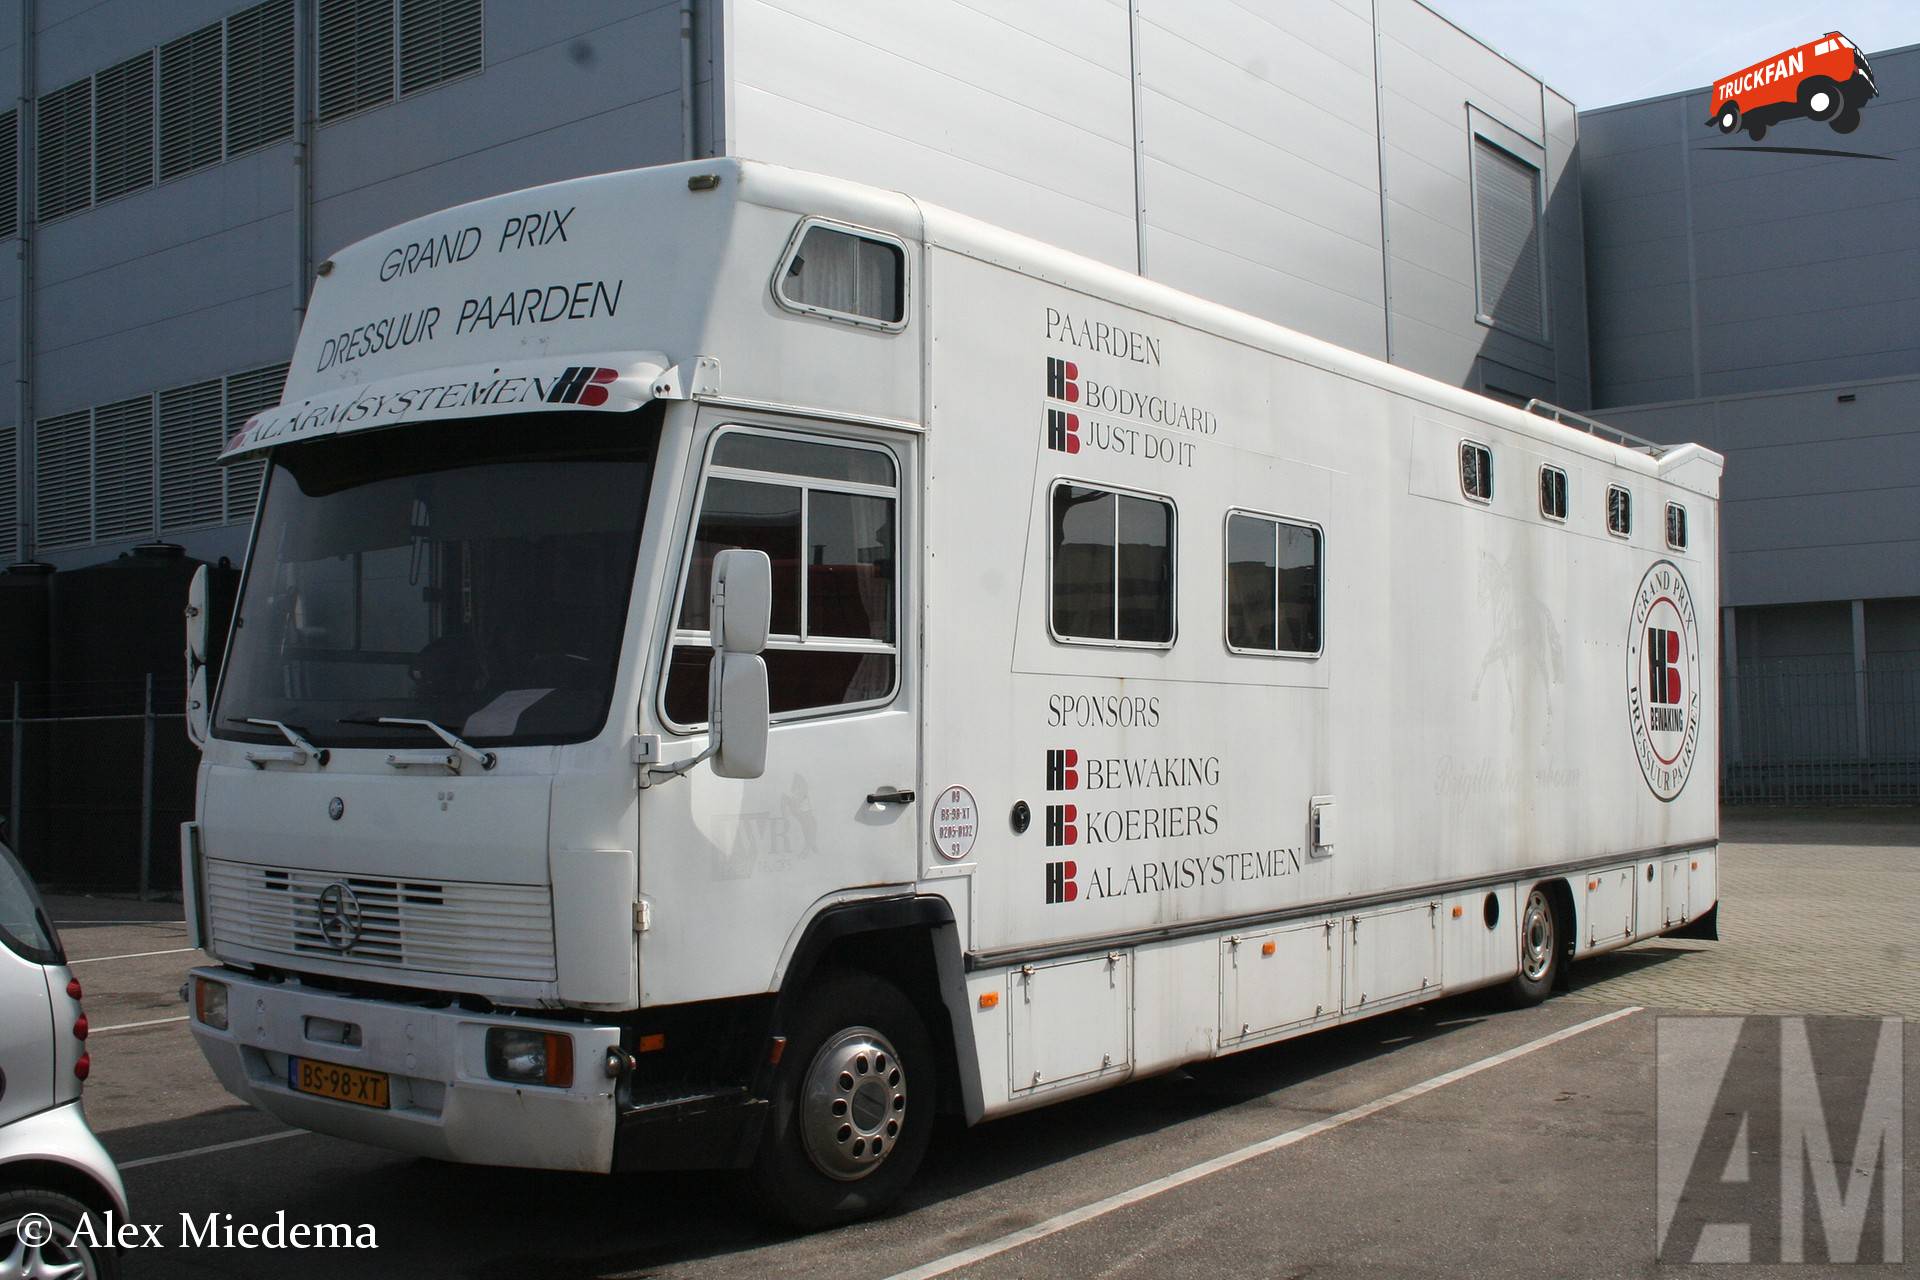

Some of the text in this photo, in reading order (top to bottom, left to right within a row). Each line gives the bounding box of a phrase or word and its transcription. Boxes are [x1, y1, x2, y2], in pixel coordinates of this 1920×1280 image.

[379, 206, 577, 283] GRAND PRIX
[316, 279, 624, 374] DRESSUUR PAARDEN
[1045, 307, 1161, 368] PAARDEN
[241, 375, 559, 447] ALARMSYSTEMEN
[1086, 380, 1217, 436] BODYGUARD
[1086, 421, 1140, 456] JUST
[1636, 570, 1694, 632] GRAND PRIX
[1047, 694, 1160, 728] SPONSORS
[1650, 706, 1684, 733] BEWAKING
[1630, 686, 1670, 791] DRESSUUR
[1672, 690, 1698, 790] PAARDEN
[1086, 756, 1220, 790] BEWAKING
[1086, 804, 1219, 844] KOERIERS
[1086, 847, 1302, 900] ALARMSYSTEMEN
[303, 1063, 380, 1101] BS-98-XT
